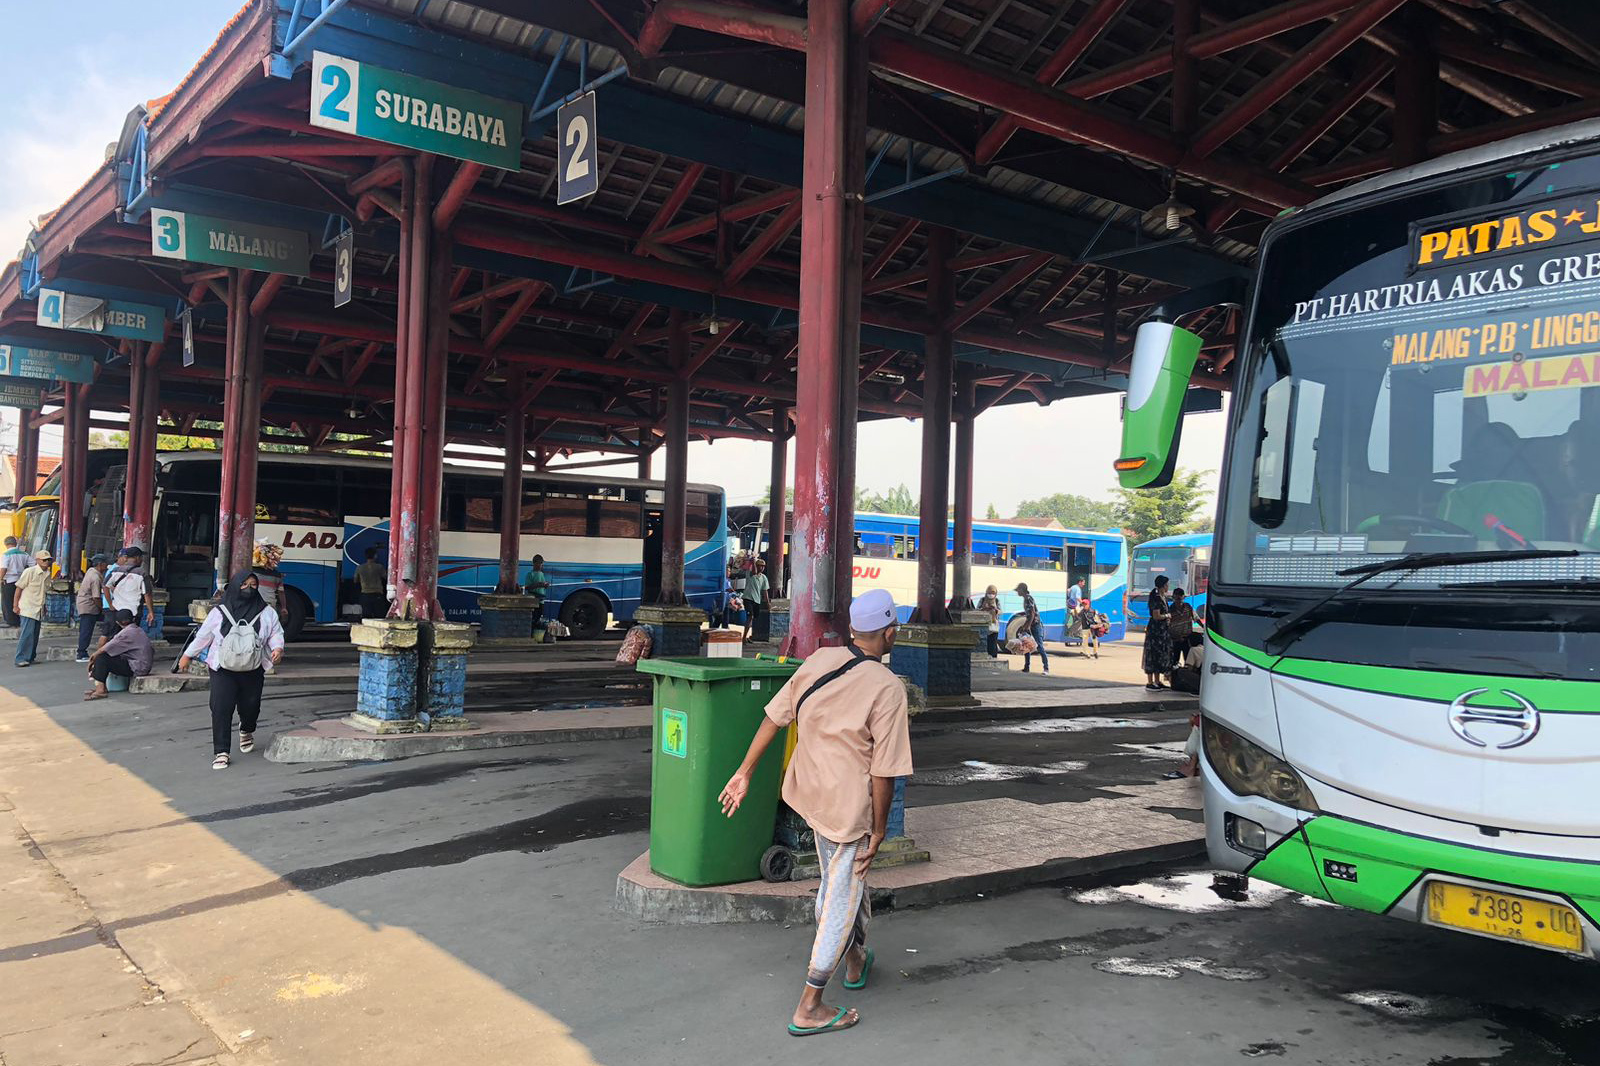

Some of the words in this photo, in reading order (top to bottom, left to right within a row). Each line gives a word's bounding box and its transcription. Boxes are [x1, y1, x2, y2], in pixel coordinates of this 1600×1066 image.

[319, 64, 352, 123] 2
[375, 89, 507, 147] SURABAYA
[565, 115, 590, 183] 2
[156, 215, 182, 252] 3
[209, 230, 289, 260] MALANG
[1417, 209, 1557, 265] PATAS
[338, 248, 350, 293] 3
[1448, 264, 1524, 301] AKAS
[41, 295, 61, 324] 4
[184, 323, 192, 355] 4
[1391, 326, 1470, 366] MALANG
[1470, 891, 1523, 925] 7388
